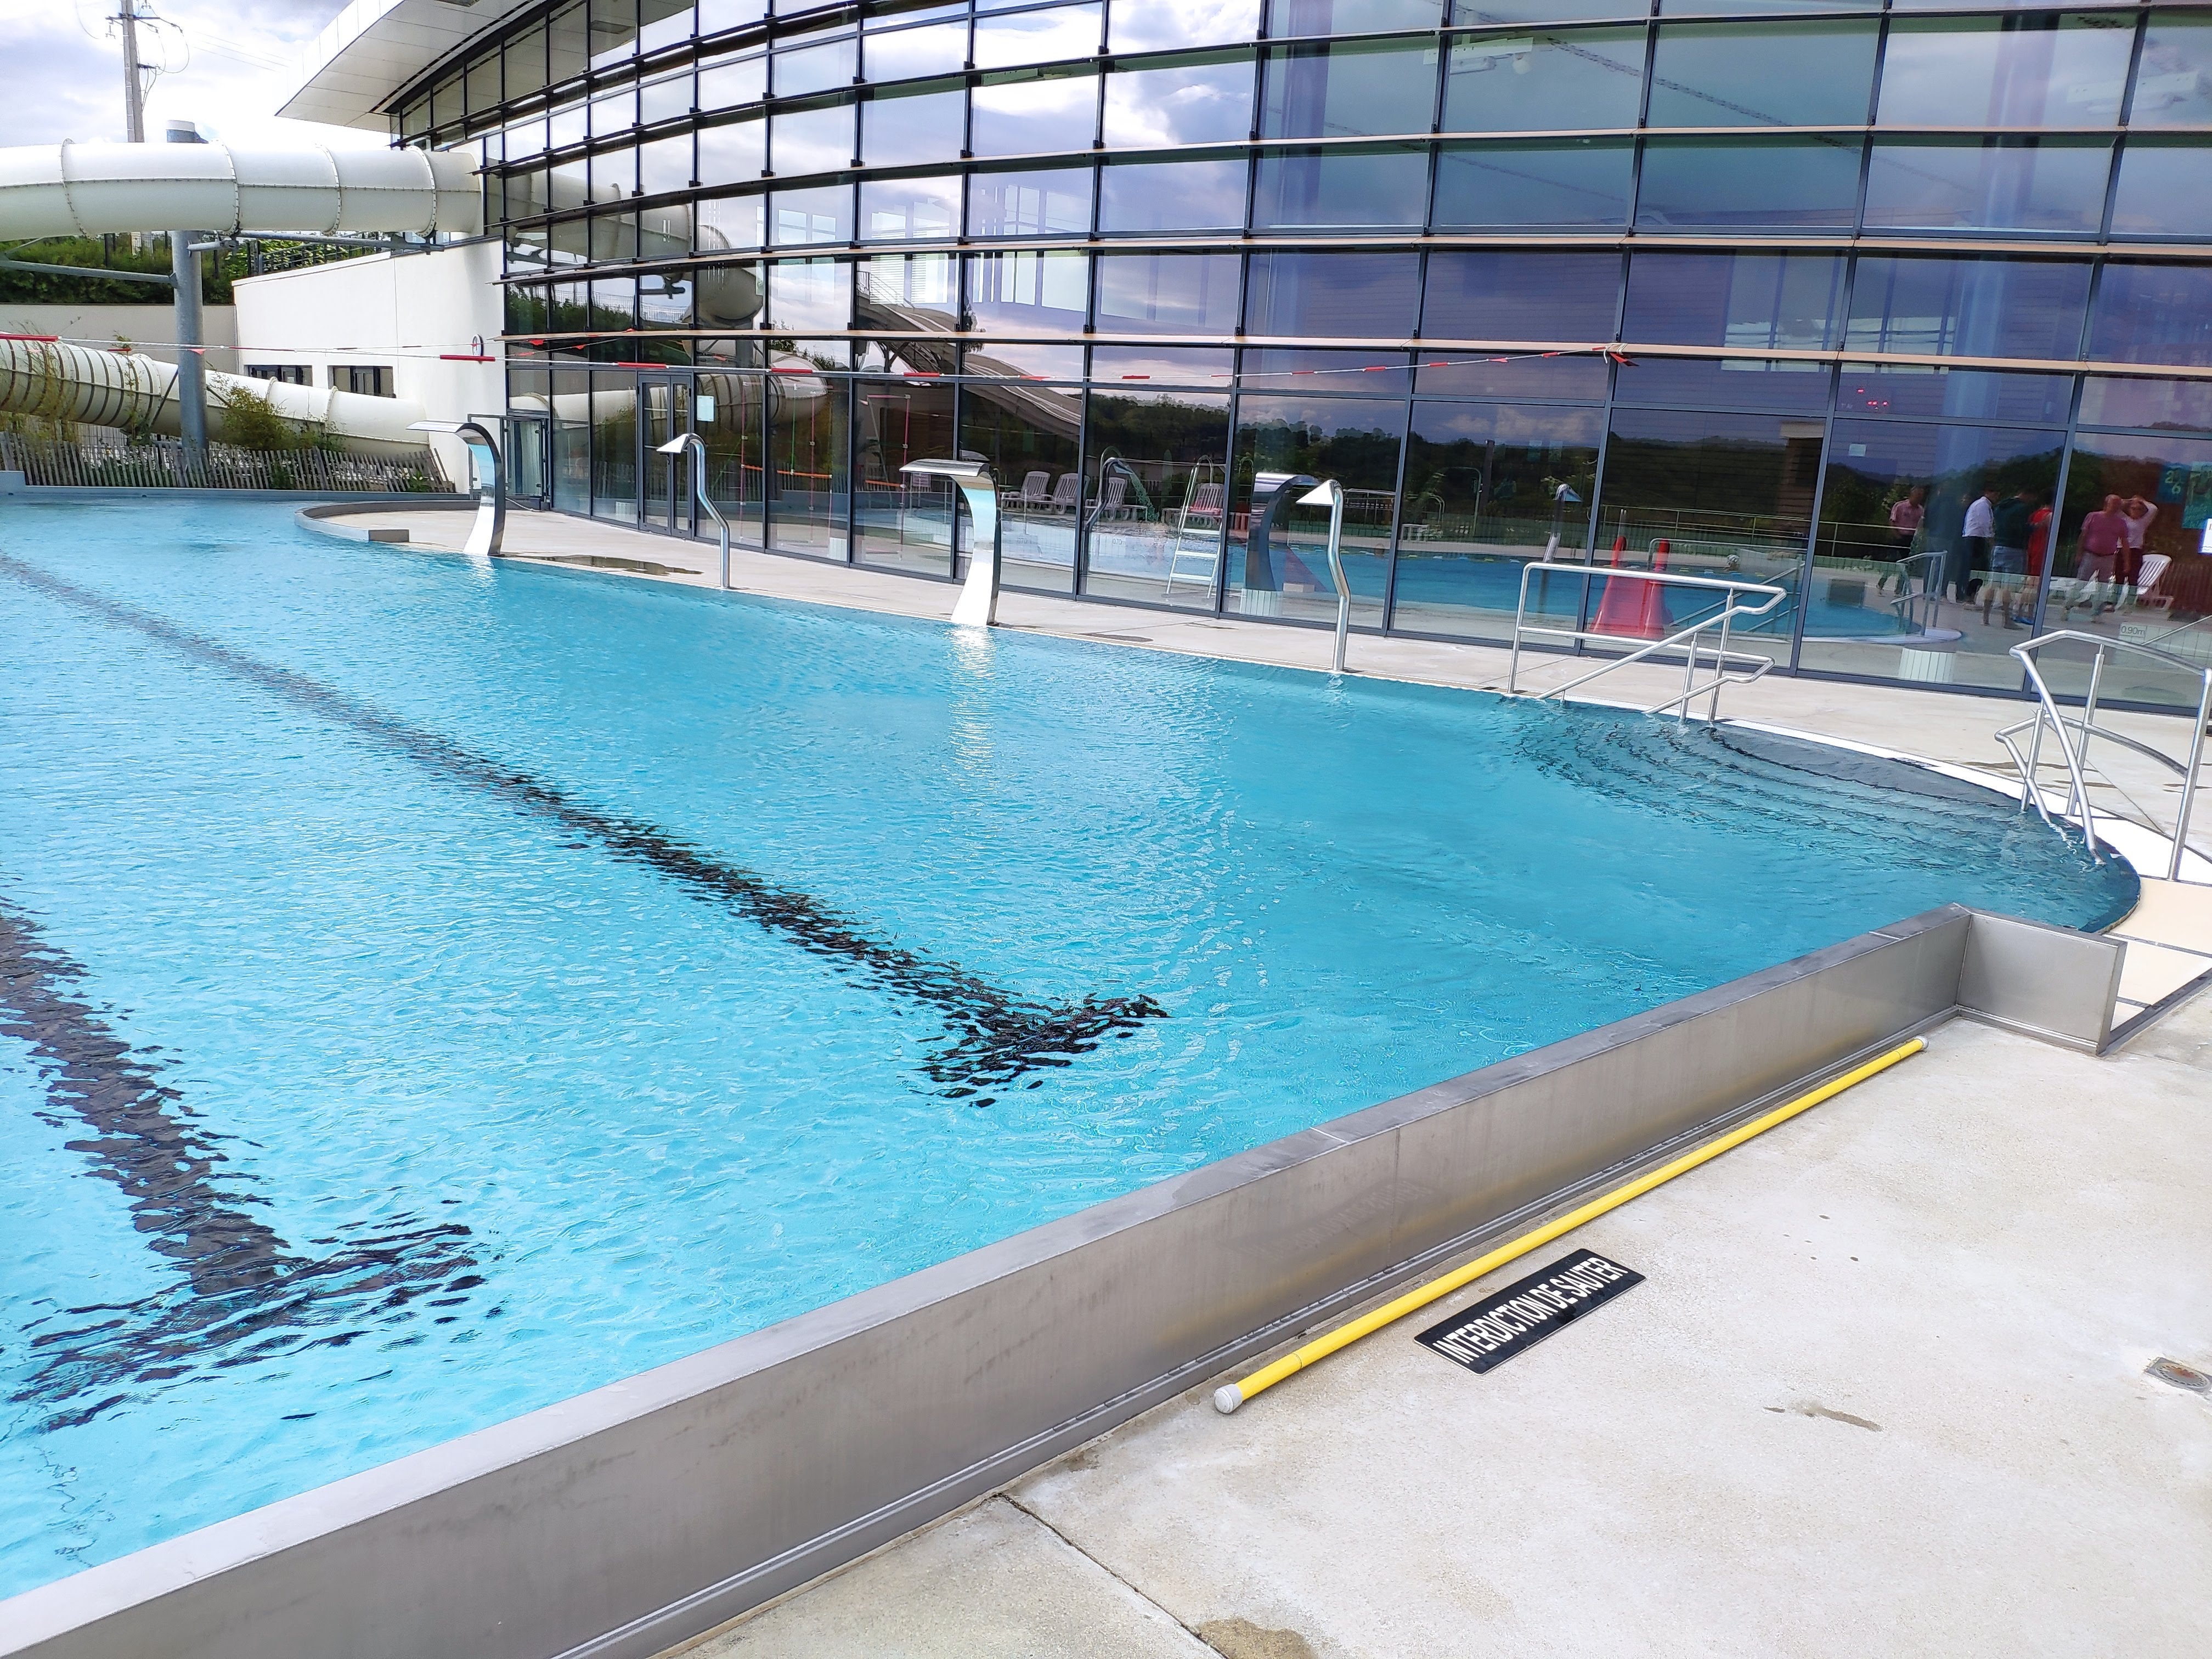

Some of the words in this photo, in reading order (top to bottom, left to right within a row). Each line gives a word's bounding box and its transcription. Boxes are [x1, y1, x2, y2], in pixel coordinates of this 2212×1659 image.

[2121, 625, 2145, 635] 0.90m
[1549, 1257, 1629, 1297] SAUTER
[1528, 1283, 1578, 1309] DE
[1432, 1294, 1558, 1364] INTERDICTION
